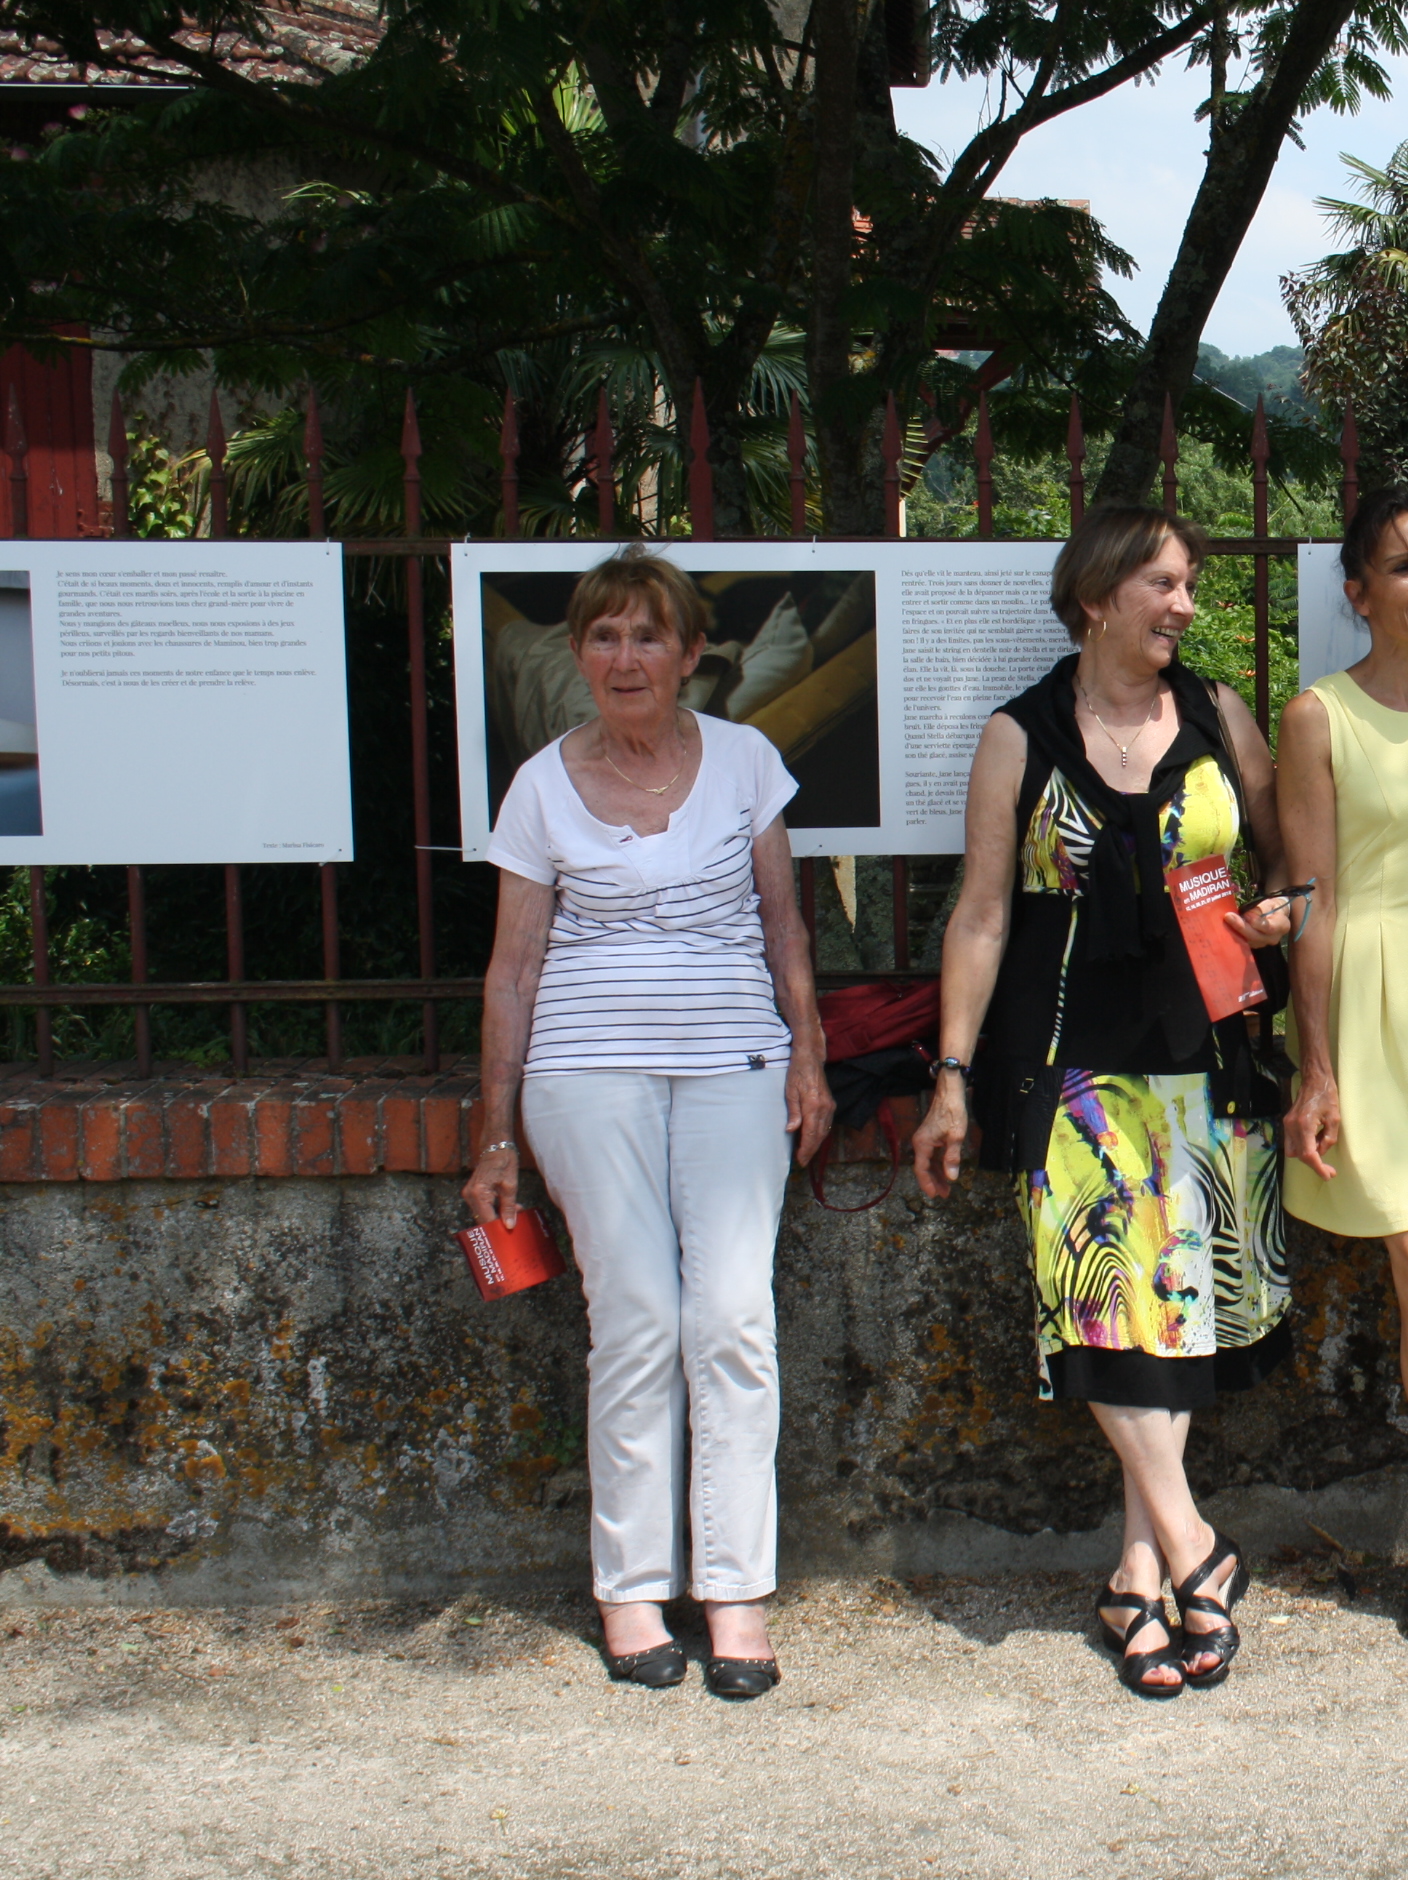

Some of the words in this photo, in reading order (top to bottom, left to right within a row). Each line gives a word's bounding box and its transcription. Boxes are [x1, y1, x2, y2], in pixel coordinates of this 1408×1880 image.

[1179, 867, 1227, 892] MUSIQUE
[1189, 879, 1230, 901] MADIRAN
[467, 1230, 494, 1284] MUSIQUE
[473, 1228, 496, 1273] MADIRAN
